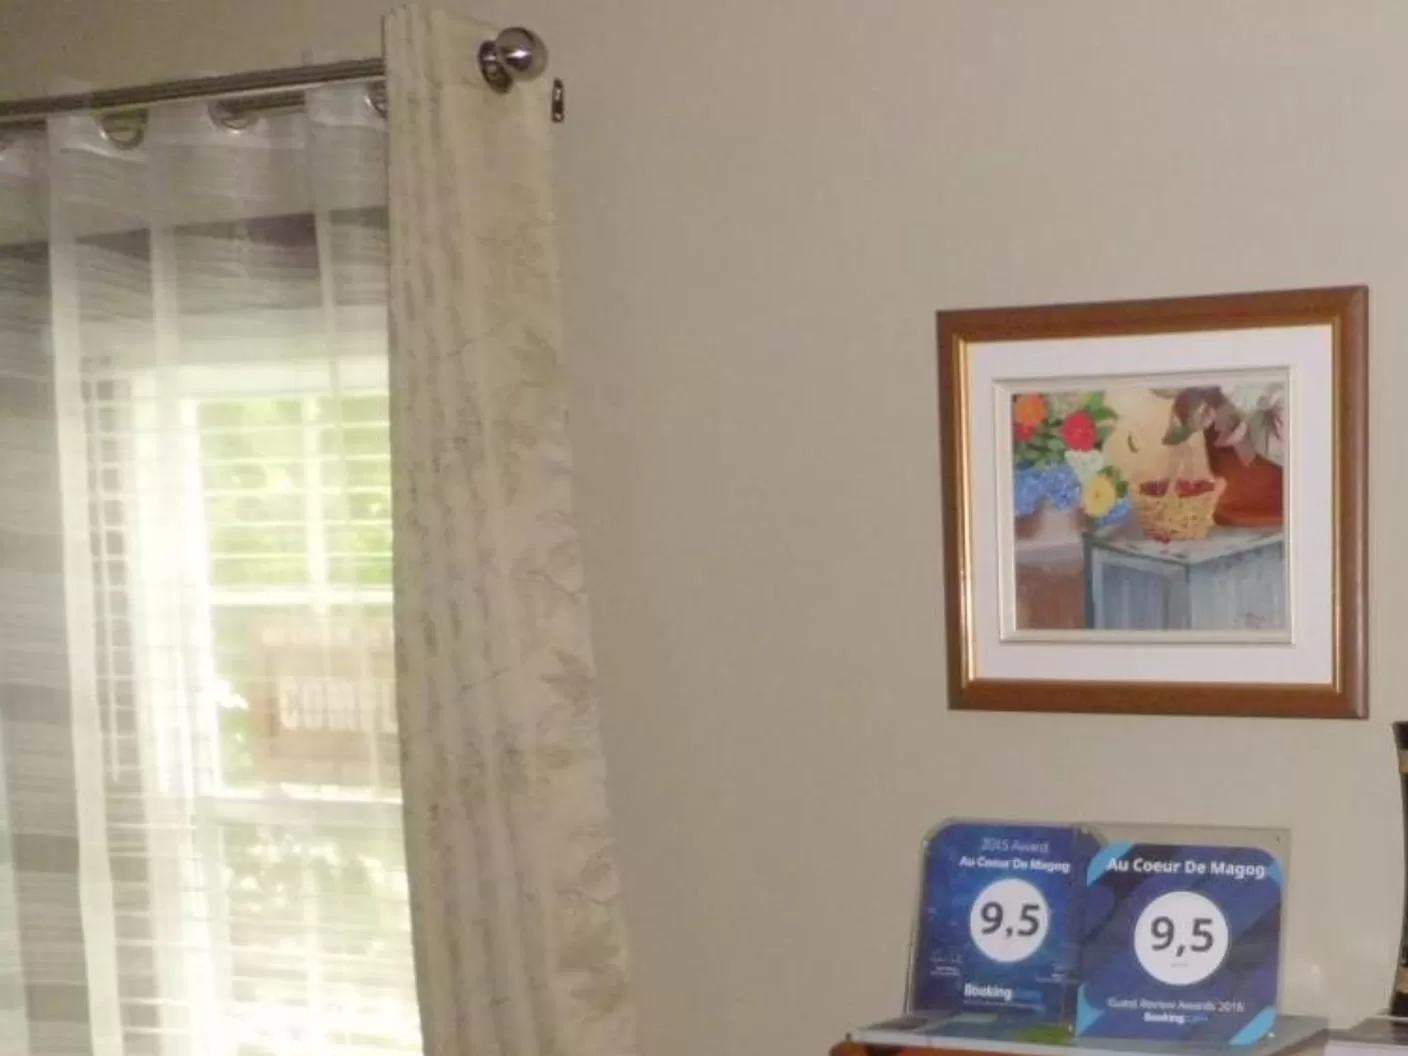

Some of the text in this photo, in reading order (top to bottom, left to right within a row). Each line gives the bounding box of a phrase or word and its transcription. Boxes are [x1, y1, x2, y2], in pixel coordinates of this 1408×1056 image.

[959, 856, 976, 867] Au
[1030, 858, 1071, 874] Magog
[1106, 857, 1266, 879] Au Coeur De Magog
[980, 901, 1041, 938] 9,5
[1150, 915, 1214, 958] 9,5
